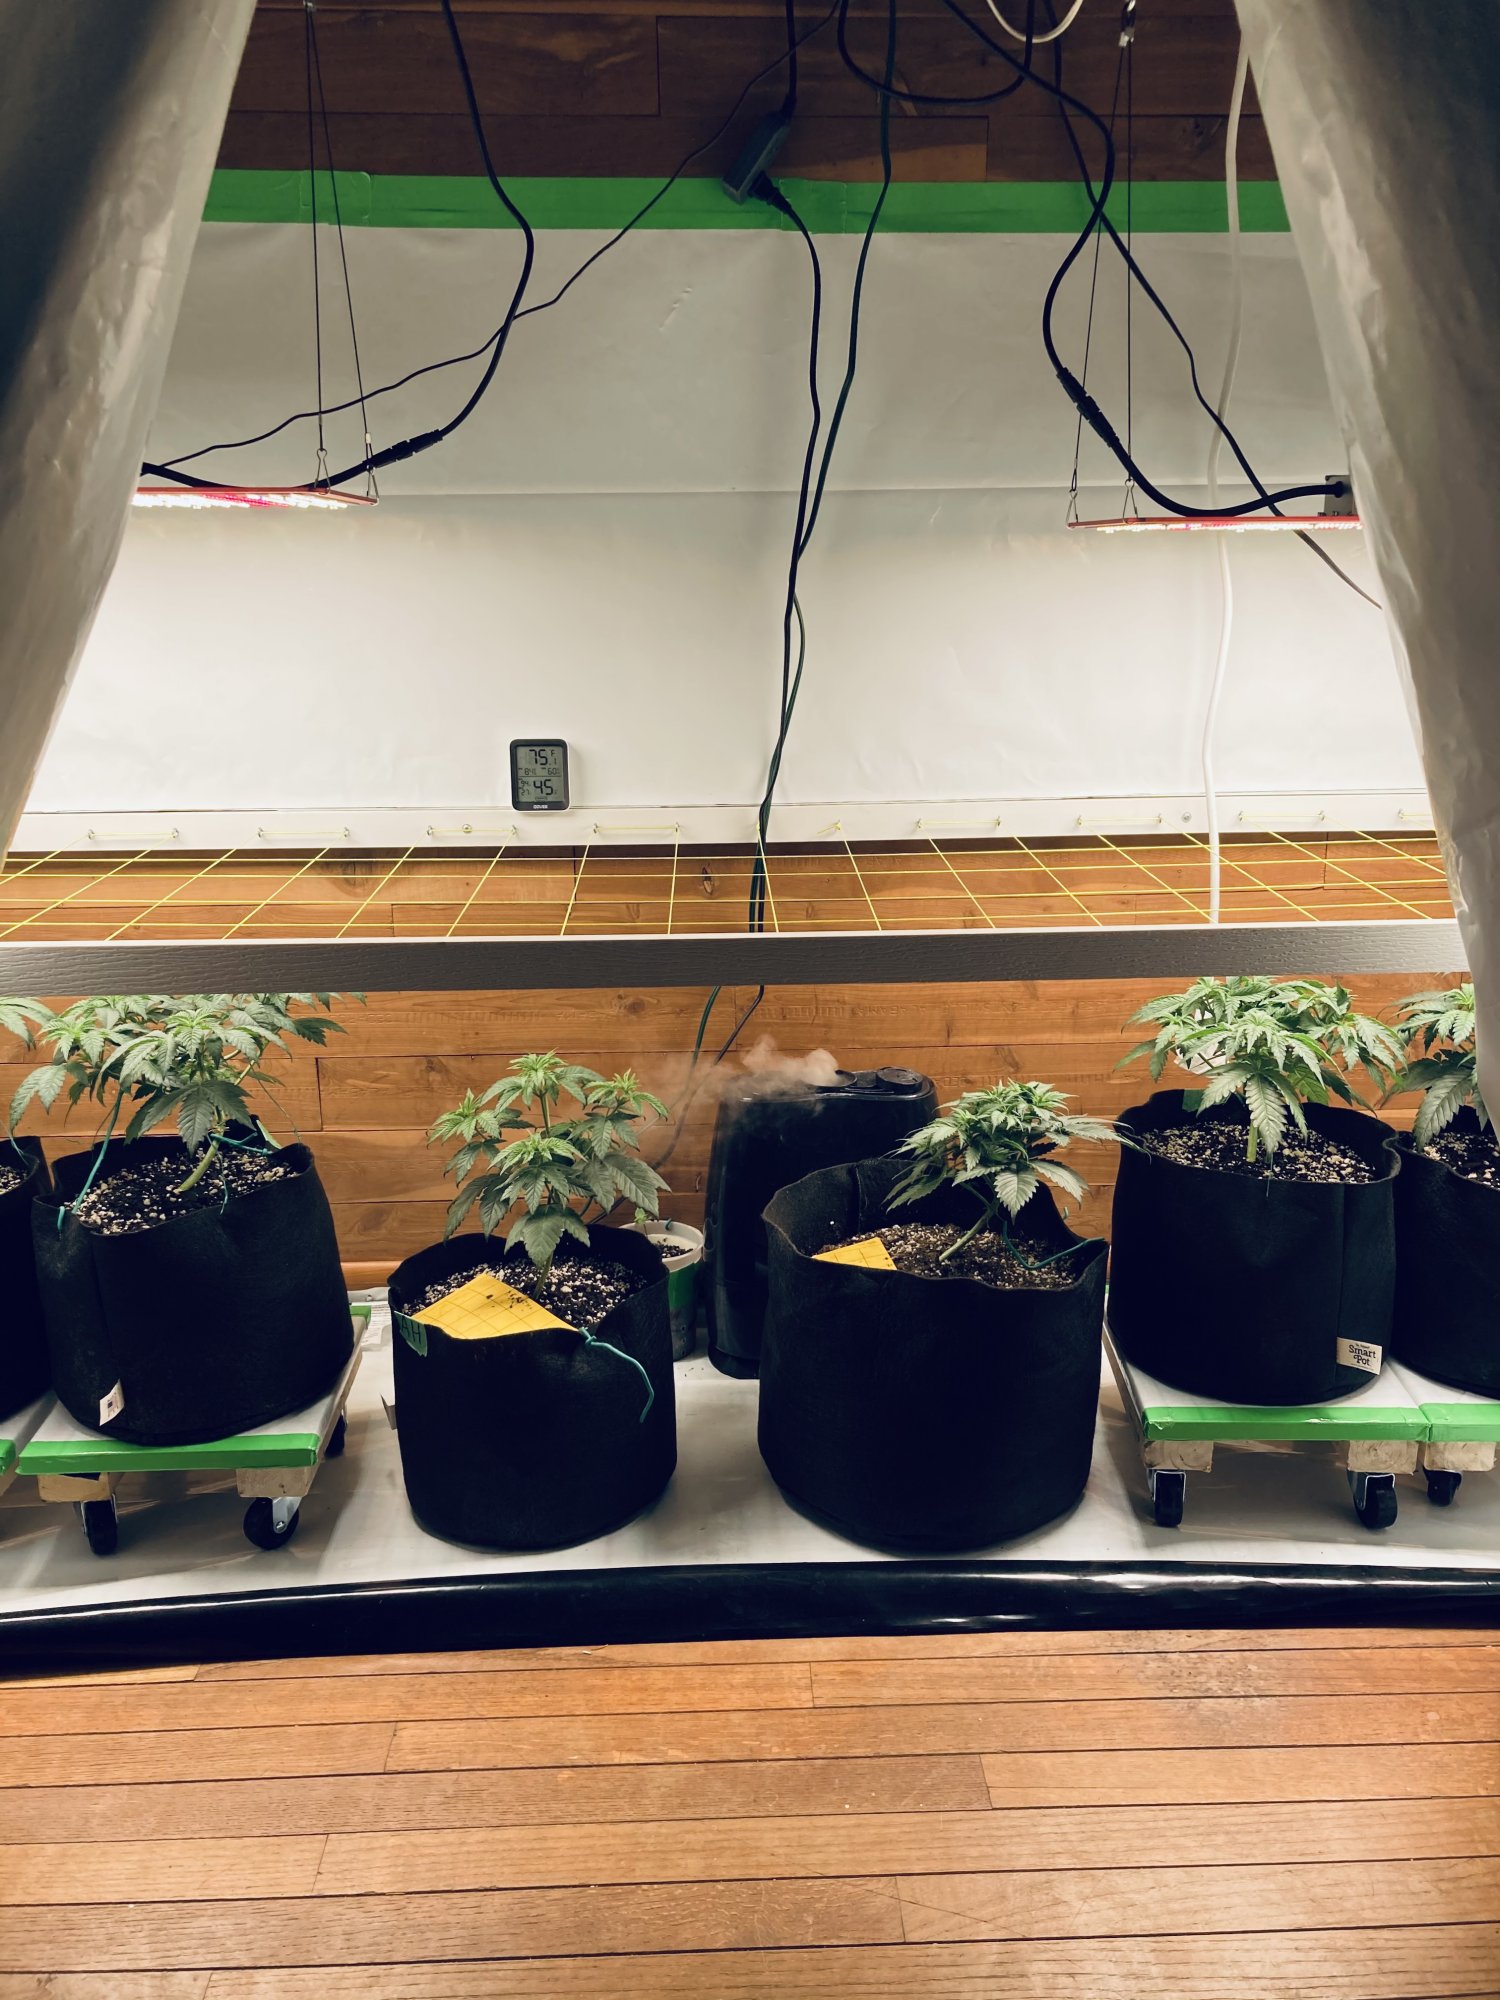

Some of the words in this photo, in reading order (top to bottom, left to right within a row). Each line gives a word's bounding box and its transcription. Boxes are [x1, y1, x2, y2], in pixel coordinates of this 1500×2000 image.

[533, 779, 553, 795] 45
[1348, 1344, 1376, 1359] Smart
[1353, 1354, 1371, 1367] Pot
